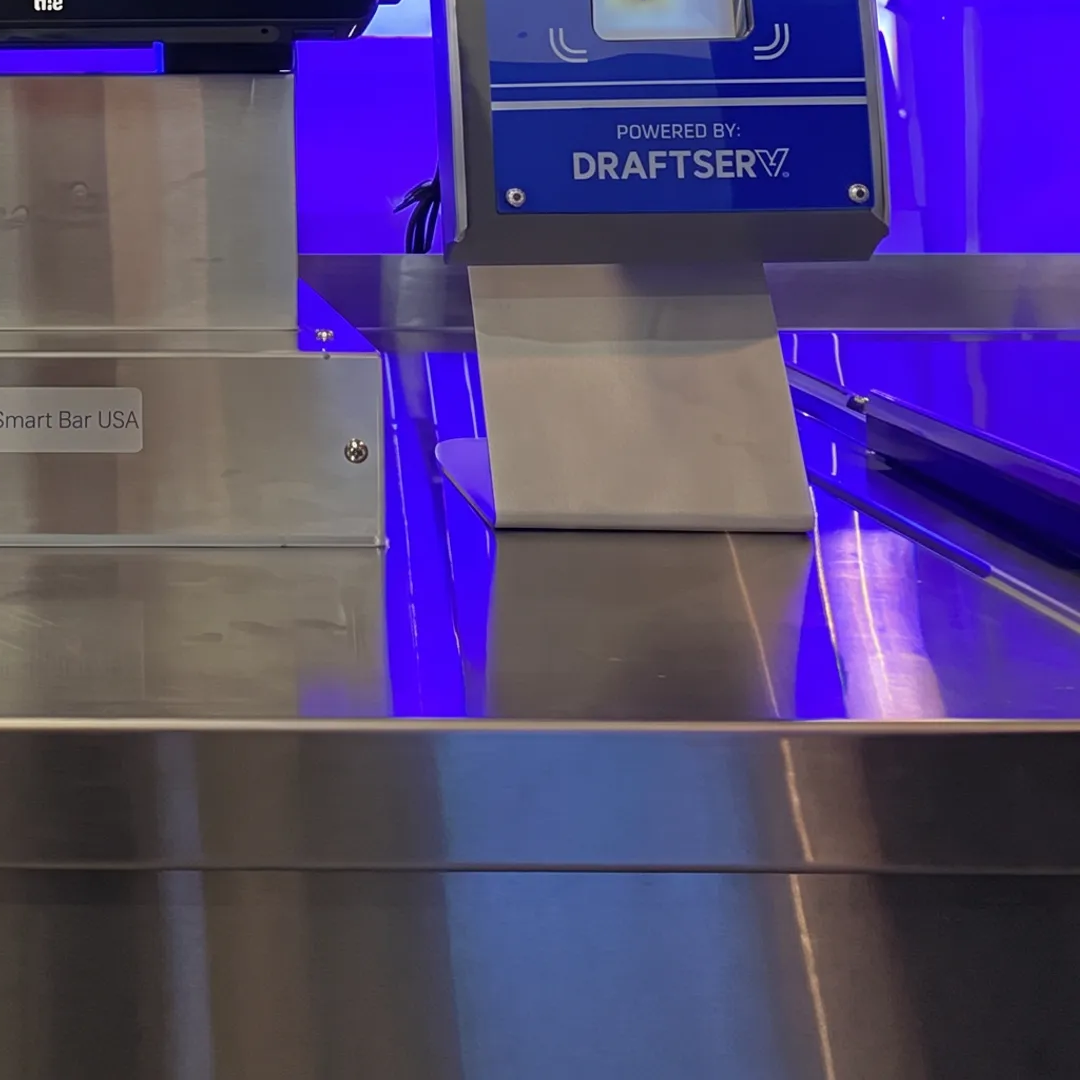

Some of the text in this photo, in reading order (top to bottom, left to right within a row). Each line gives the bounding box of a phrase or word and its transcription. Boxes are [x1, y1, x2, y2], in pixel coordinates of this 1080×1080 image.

[617, 123, 741, 140] POWERED BY:
[572, 147, 790, 180] DRAFTSERV
[59, 410, 92, 429] Bar
[98, 410, 139, 429] USA
